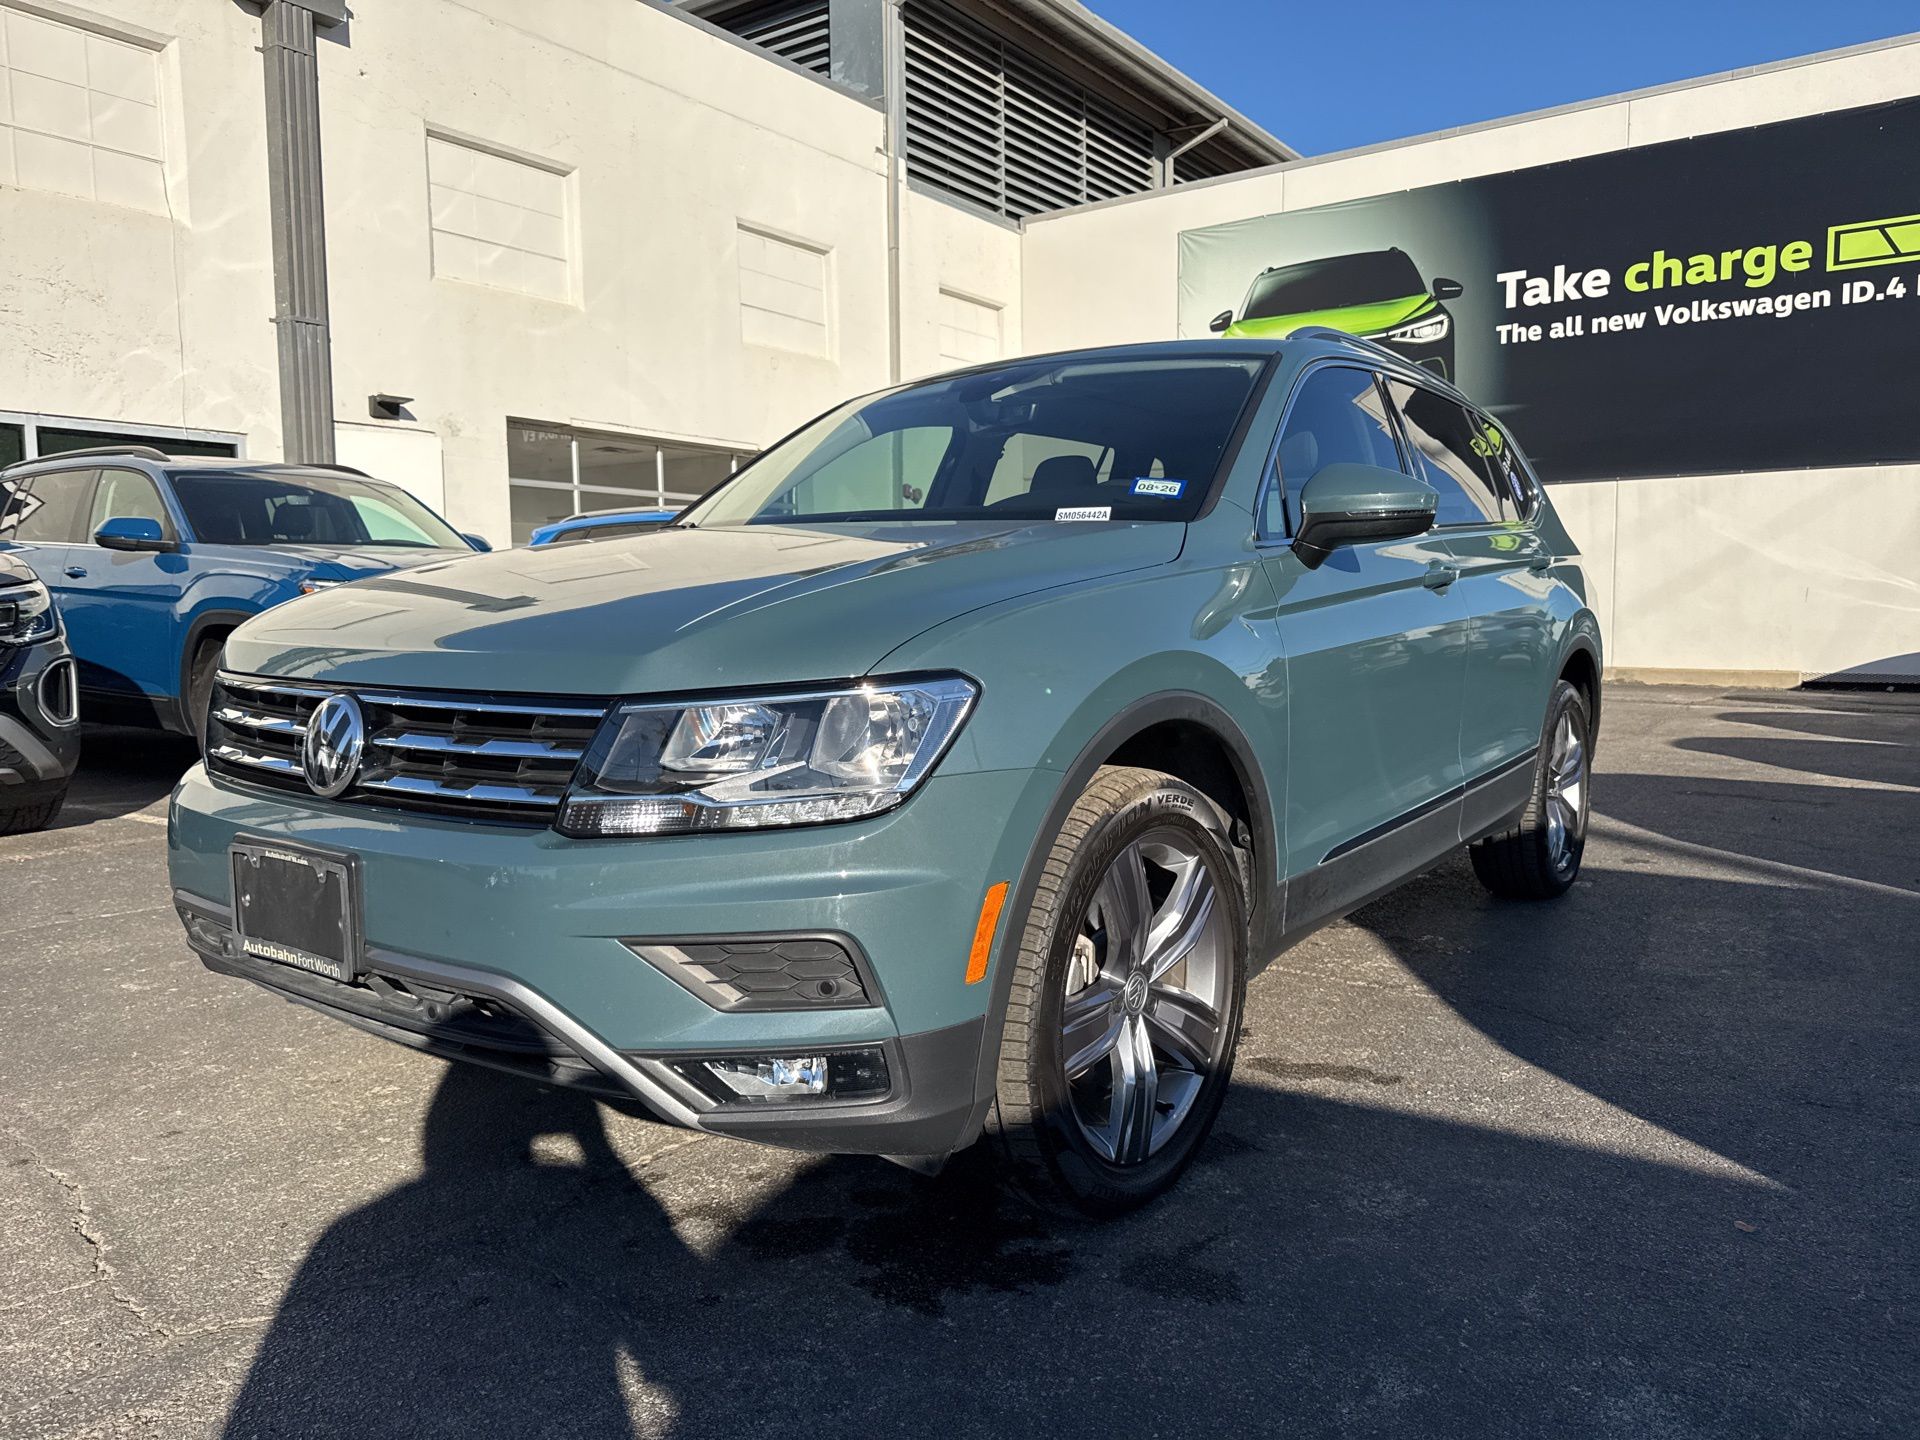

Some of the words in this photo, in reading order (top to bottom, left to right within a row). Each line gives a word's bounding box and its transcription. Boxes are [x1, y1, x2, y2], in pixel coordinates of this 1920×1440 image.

[1496, 264, 1611, 309] Take
[1624, 239, 1813, 293] charge
[1496, 323, 1542, 345] The
[1549, 315, 1584, 339] all
[1591, 313, 1646, 335] new
[1654, 287, 1831, 326] Volkswagen
[1842, 276, 1907, 305] ID.4
[1057, 510, 1108, 520] SM056442A
[1156, 794, 1195, 807] VERDE
